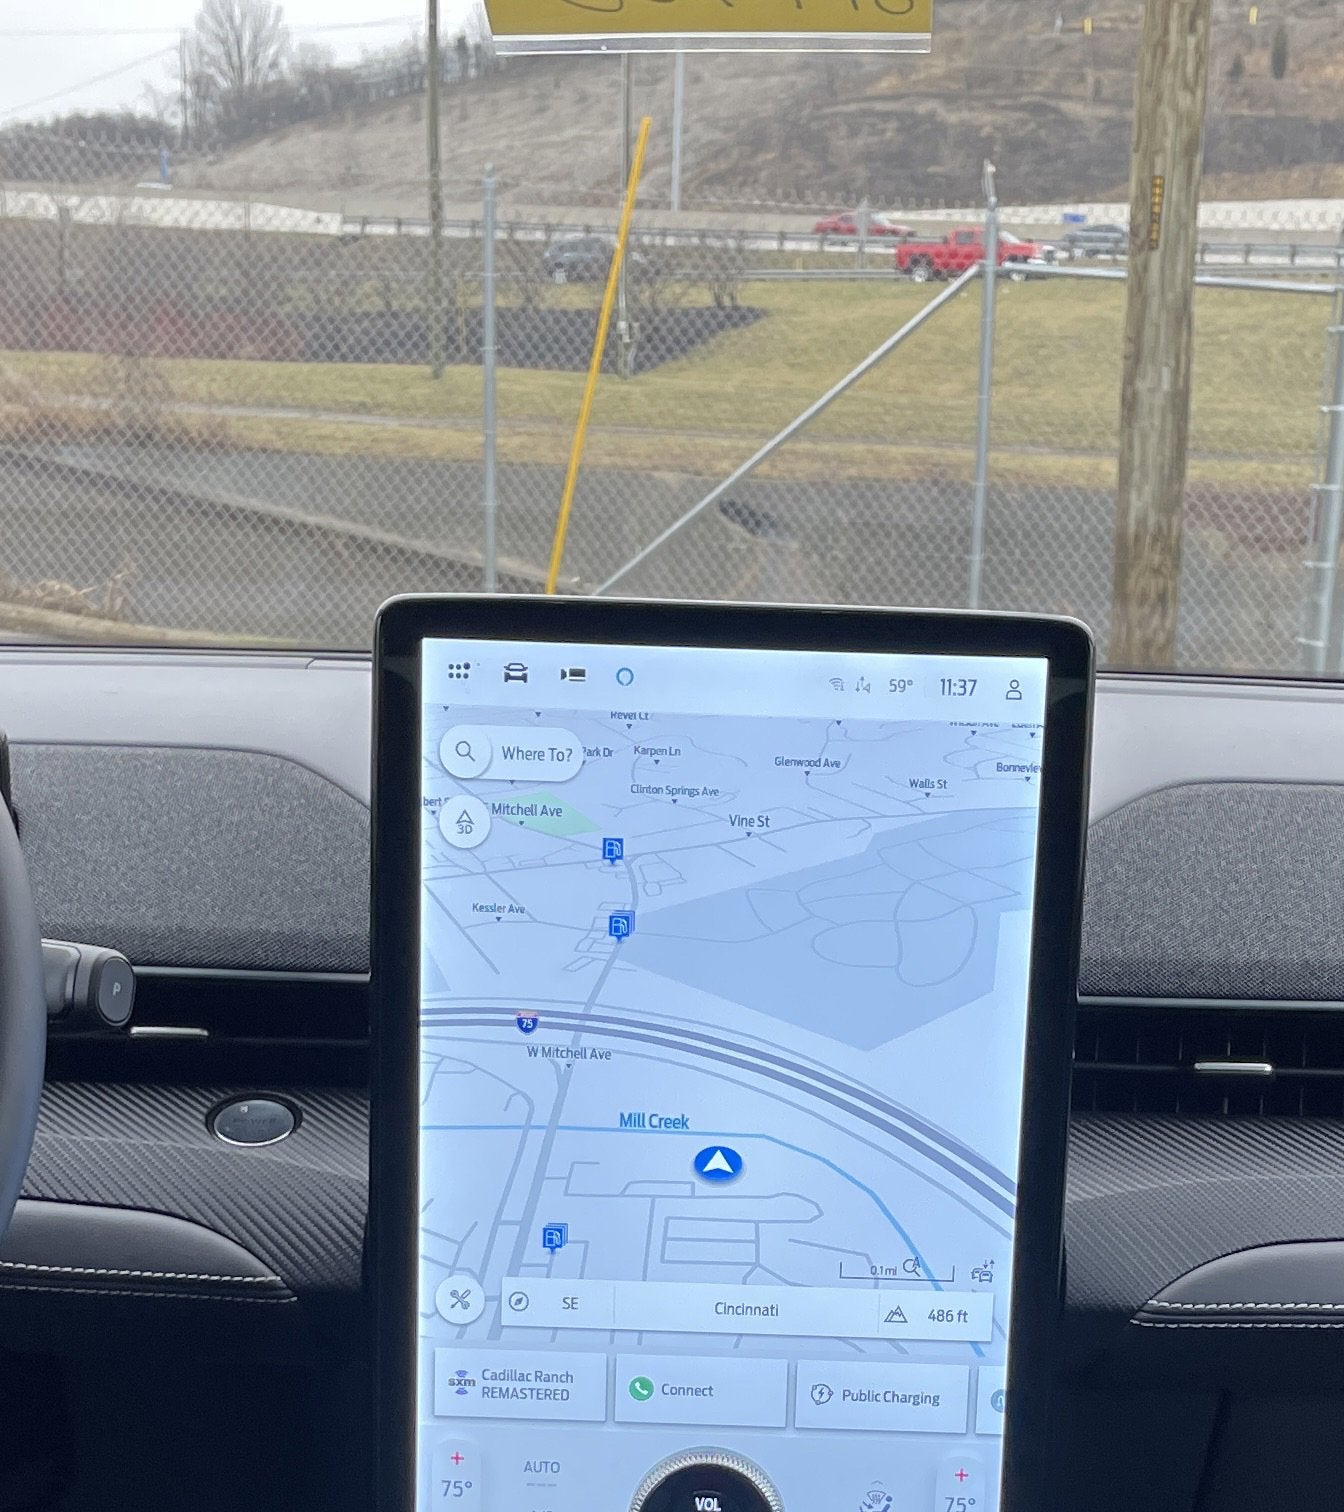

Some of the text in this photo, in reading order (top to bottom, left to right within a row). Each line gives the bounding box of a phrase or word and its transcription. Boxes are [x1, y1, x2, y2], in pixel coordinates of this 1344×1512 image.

[889, 678, 913, 693] 59°
[940, 678, 977, 697] 11:37
[502, 746, 573, 762] Where To?
[634, 746, 667, 758] Karpen
[774, 757, 841, 768] Glenwood Ave
[909, 778, 947, 789] Walls St
[630, 784, 719, 798] Clinton Springs Ave
[491, 804, 563, 817] Mitchell Ave
[729, 814, 770, 828] Vine St
[457, 824, 473, 834] 3D
[472, 903, 525, 914] Kessler Ave
[522, 1018, 533, 1028] 75
[527, 1046, 612, 1060] W Mitchell Ave
[620, 1112, 690, 1130] Mill Creek
[562, 1297, 579, 1309] SE
[715, 1302, 779, 1317] Cincinnati
[928, 1308, 969, 1323] 486 ft
[482, 1369, 574, 1384] Cadillac Ranch
[482, 1386, 570, 1401] REMASTERED
[661, 1384, 714, 1397] Connect
[842, 1389, 940, 1407] Public Charging
[524, 1460, 561, 1473] AUTO
[441, 1480, 472, 1497] 75°
[695, 1497, 722, 1512] VOL
